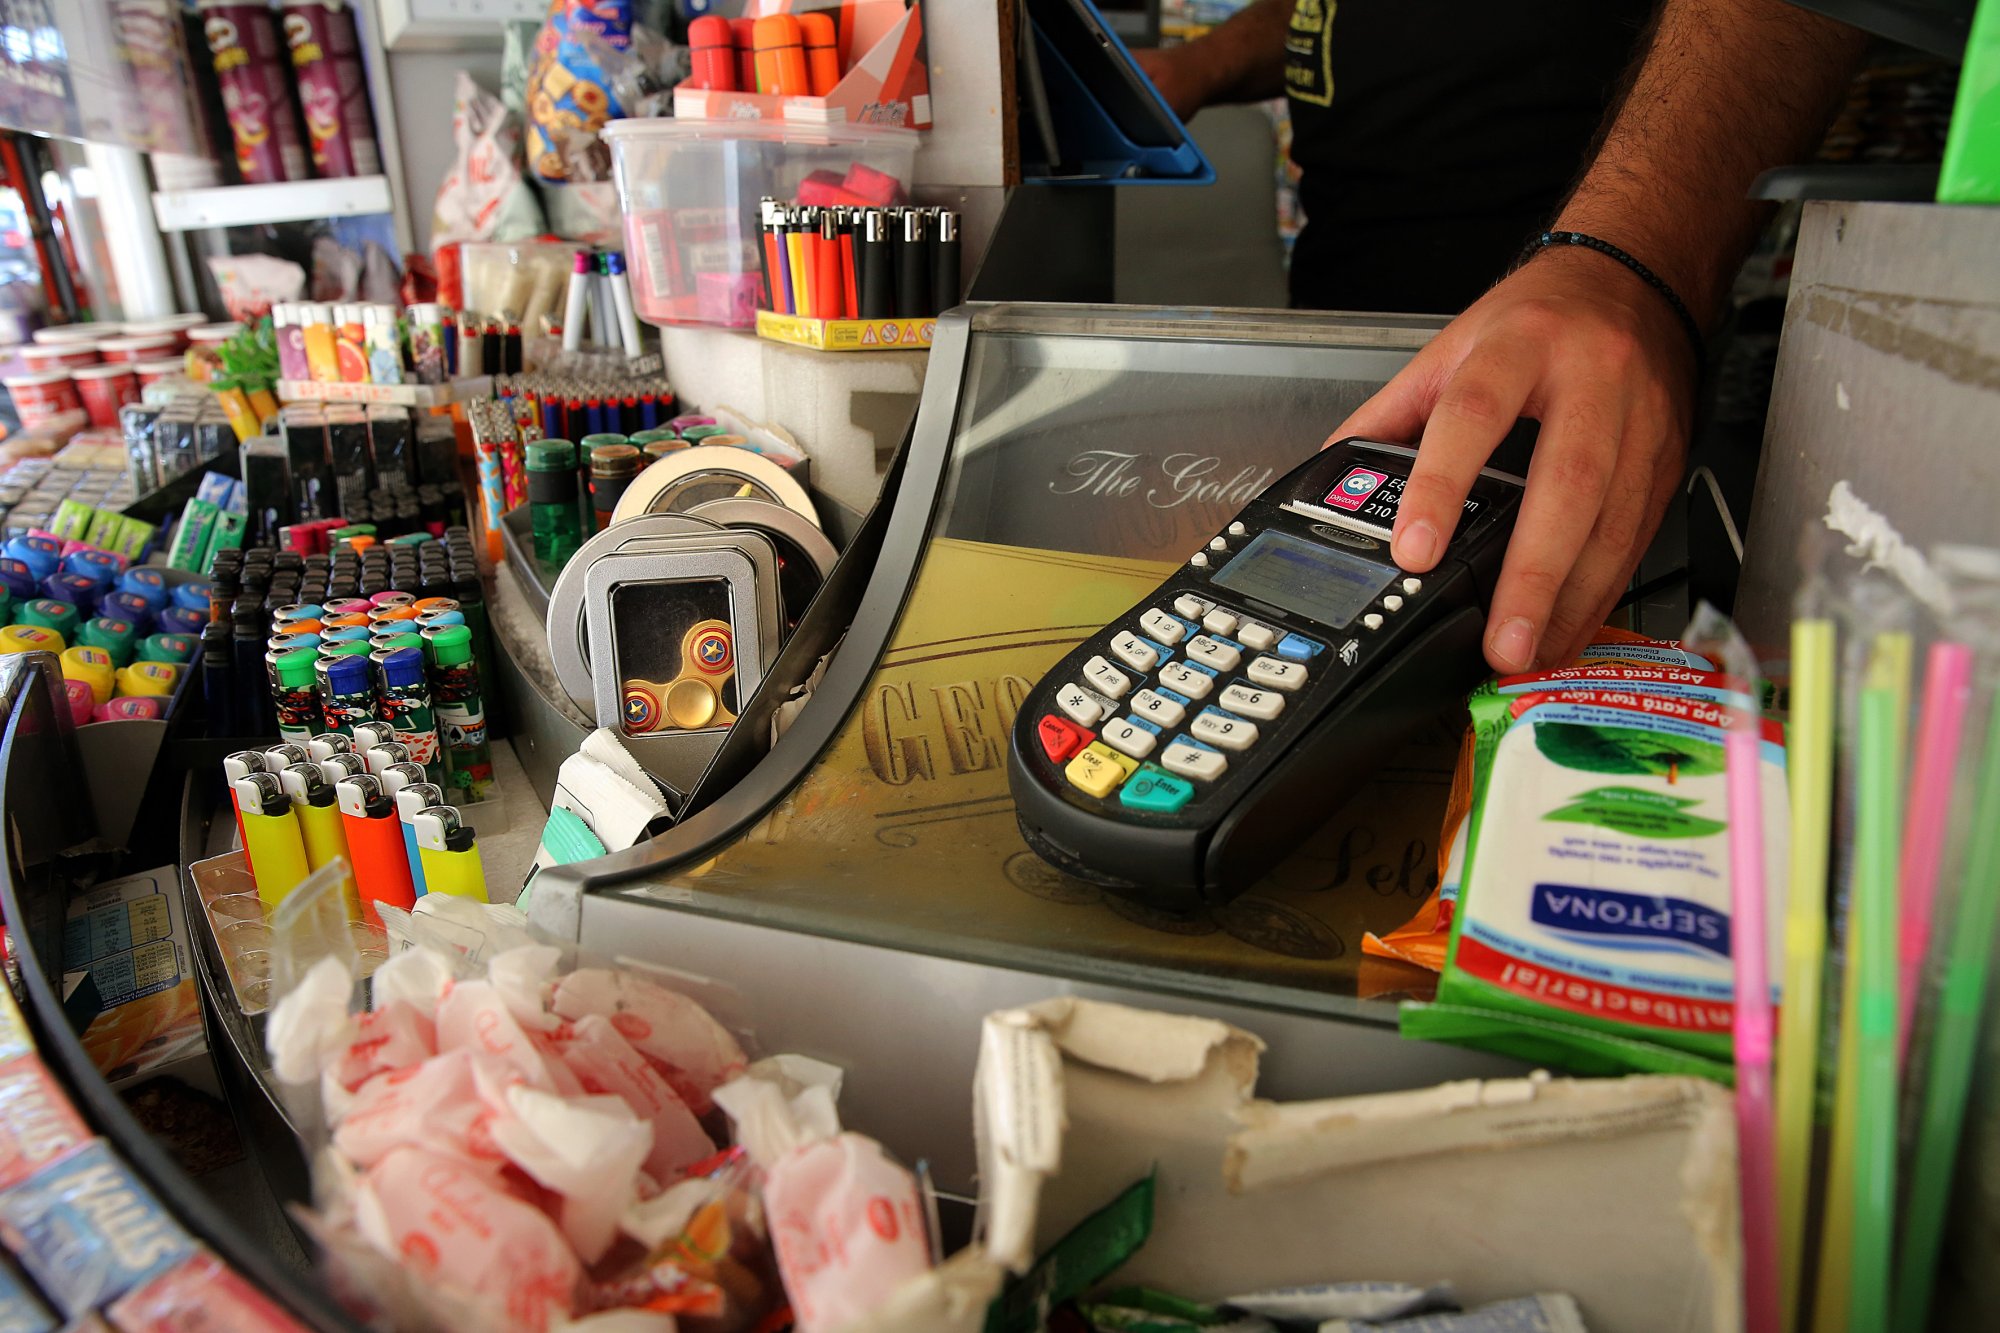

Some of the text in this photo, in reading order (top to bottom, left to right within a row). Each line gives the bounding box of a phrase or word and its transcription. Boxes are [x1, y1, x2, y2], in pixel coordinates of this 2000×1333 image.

[1048, 450, 1142, 497] The
[1329, 493, 1360, 507] payzone
[1153, 616, 1163, 625] 1
[1194, 637, 1218, 654] ABC 2
[1096, 666, 1119, 684] 7 PRS
[1178, 671, 1191, 681] 5
[1257, 661, 1288, 676] DEF 3
[1586, 669, 1619, 677] των
[1623, 670, 1663, 680] κατά
[1669, 673, 1705, 685] Δρα
[1140, 691, 1162, 710] TUV 8
[1230, 689, 1262, 704] MNO 6
[1601, 692, 1638, 706] των
[1641, 698, 1689, 716] κατά
[1692, 707, 1735, 729] Δρα
[1043, 721, 1064, 735] Cancel
[1120, 727, 1133, 739] 0
[1220, 723, 1233, 734] 9
[1082, 752, 1102, 767] Clear
[1109, 750, 1119, 761] NO
[1155, 777, 1180, 797] Enter
[1543, 890, 1721, 941] SEPTONA
[1501, 962, 1734, 1029] ntibacterial
